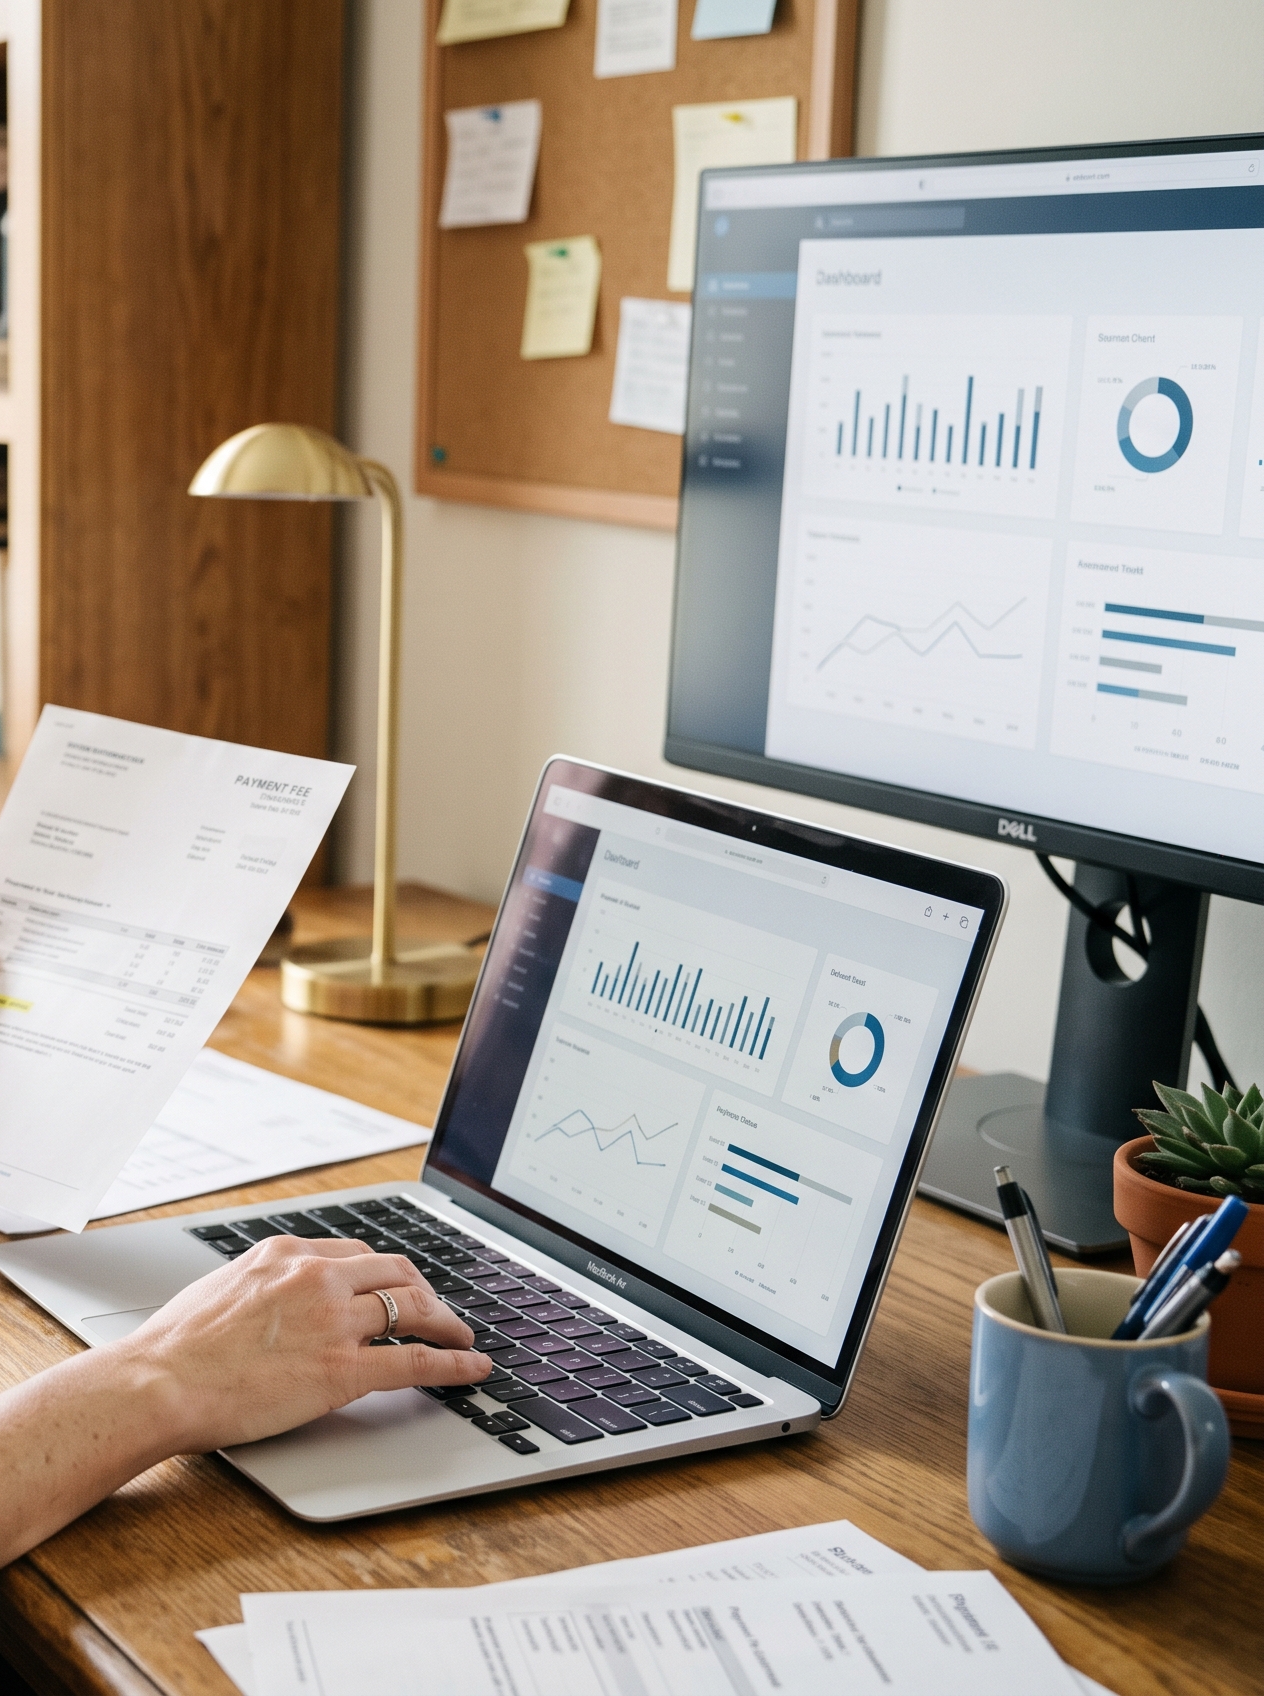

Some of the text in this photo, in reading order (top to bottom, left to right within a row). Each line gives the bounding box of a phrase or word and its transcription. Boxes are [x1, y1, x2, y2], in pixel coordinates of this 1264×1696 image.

[816, 269, 882, 286] Dashboard
[234, 775, 313, 798] PAYMENT FEE
[998, 818, 1037, 842] DELL
